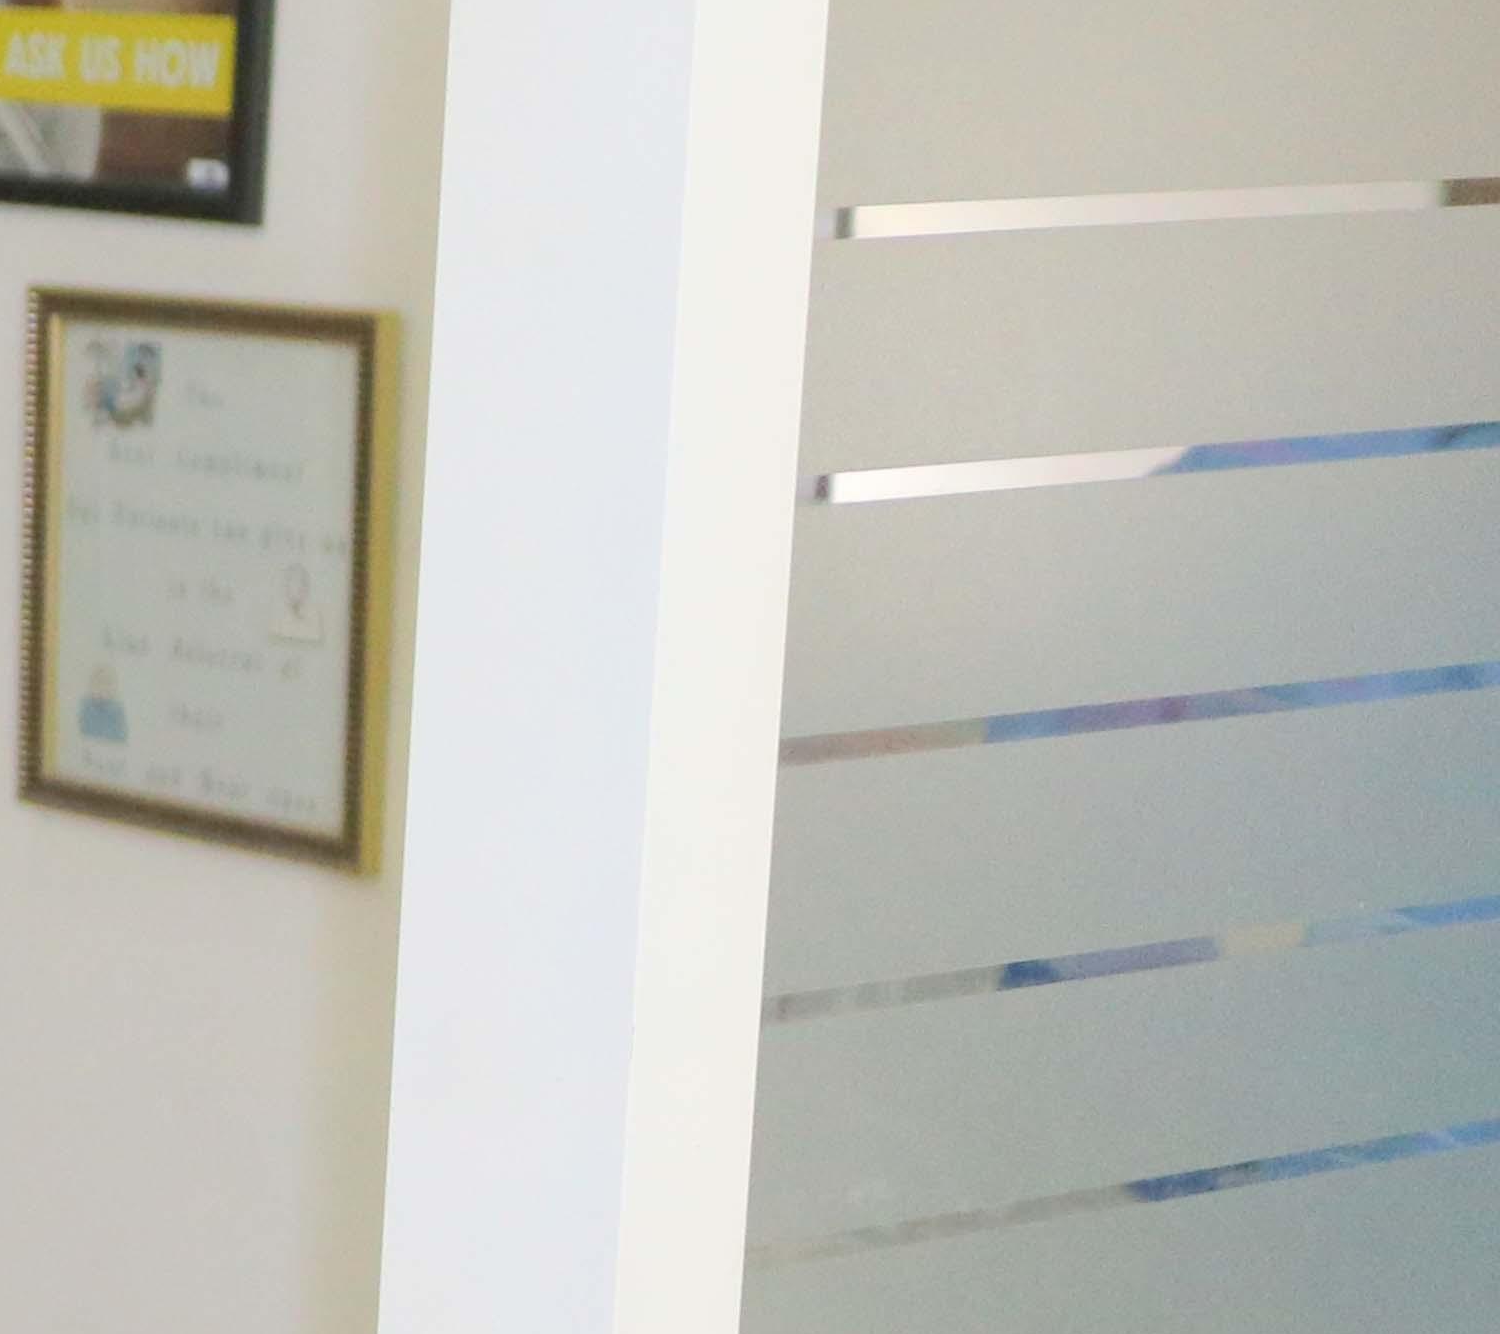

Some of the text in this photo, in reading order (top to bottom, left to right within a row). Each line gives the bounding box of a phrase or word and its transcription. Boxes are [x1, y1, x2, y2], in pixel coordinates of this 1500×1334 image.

[4, 31, 221, 91] ASK US HOW
